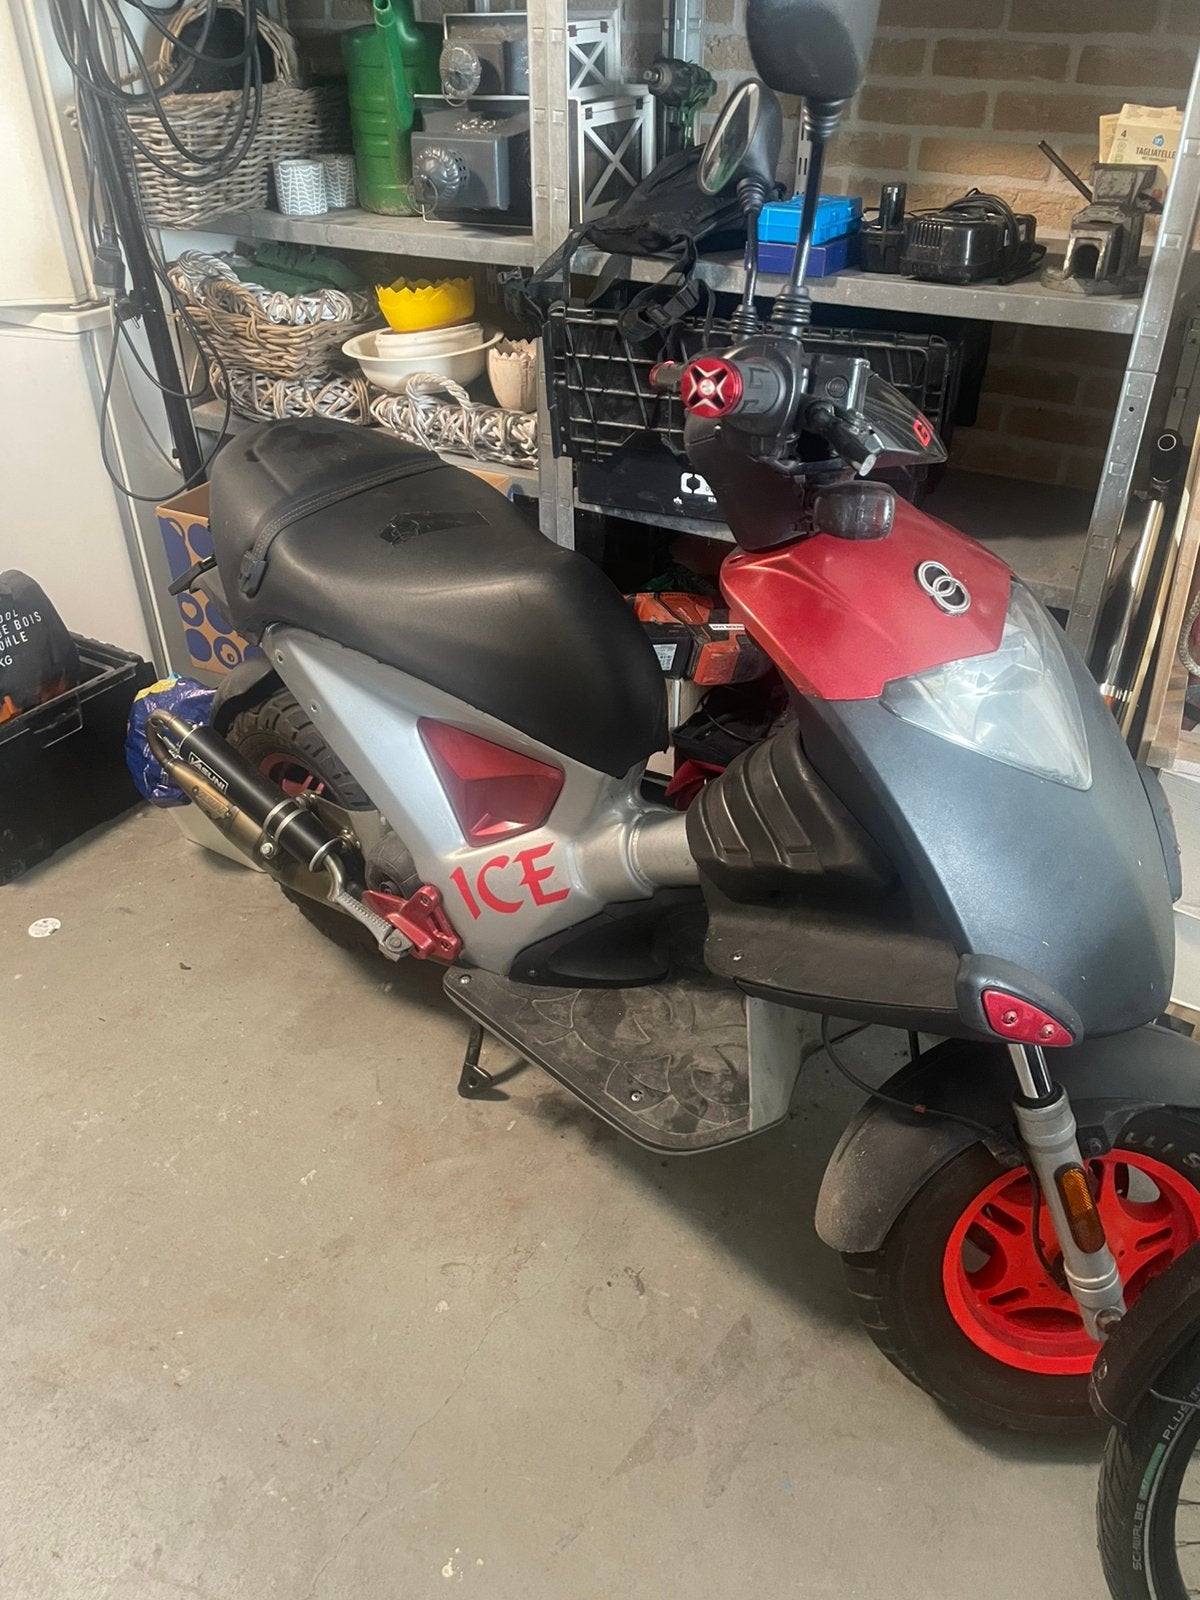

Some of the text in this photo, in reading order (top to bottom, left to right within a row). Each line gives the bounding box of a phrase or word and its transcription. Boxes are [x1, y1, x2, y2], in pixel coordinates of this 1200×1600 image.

[1120, 129, 1127, 138] 4
[1136, 147, 1177, 160] TAGLIATELLE
[13, 611, 42, 630] BOIS
[189, 756, 227, 791] VASUNI
[449, 841, 572, 921] ICE
